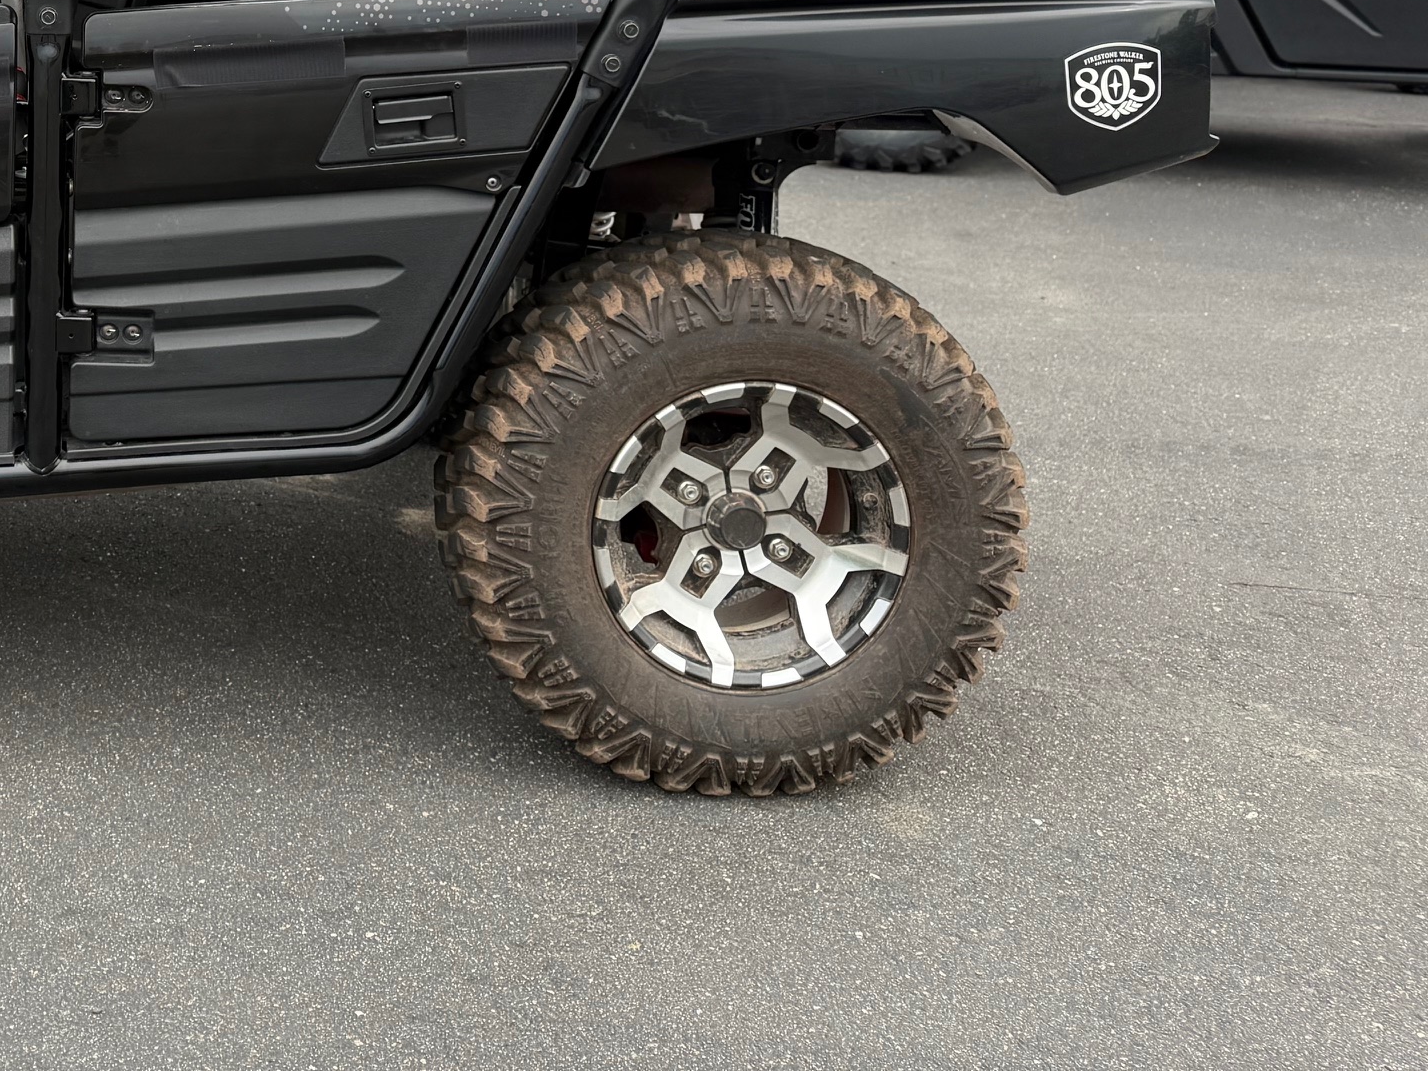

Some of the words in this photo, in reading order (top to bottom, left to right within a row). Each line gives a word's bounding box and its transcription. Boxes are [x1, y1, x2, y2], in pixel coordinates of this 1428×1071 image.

[1083, 51, 1119, 66] FIRESTONE
[1119, 51, 1145, 61] WALKER
[1073, 61, 1156, 109] 805
[738, 193, 755, 231] FO
